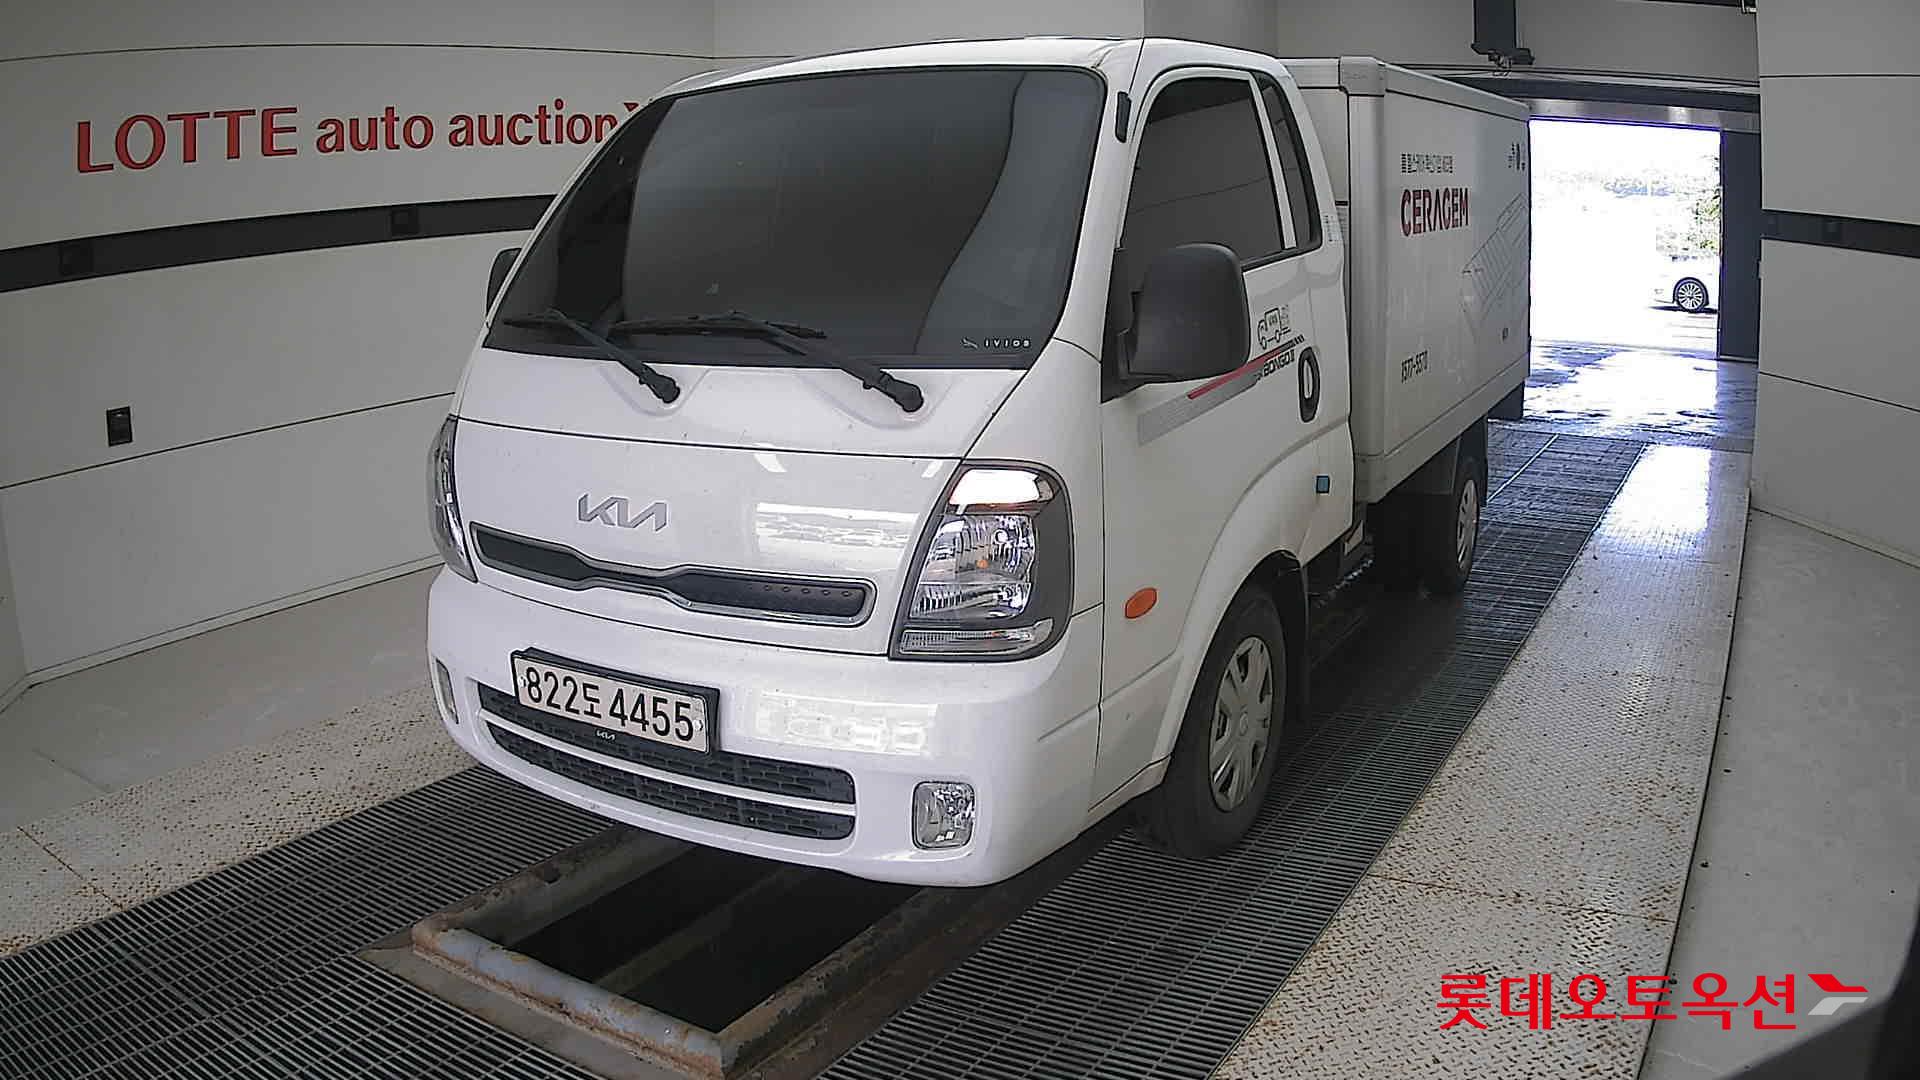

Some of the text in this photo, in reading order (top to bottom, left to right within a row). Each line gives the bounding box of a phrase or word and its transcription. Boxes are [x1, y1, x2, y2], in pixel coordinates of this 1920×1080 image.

[77, 98, 618, 173] LOTTE auto auction
[1401, 187, 1470, 237] CERAGEM
[578, 494, 667, 531] KIA
[526, 666, 694, 741] 822도 4455
